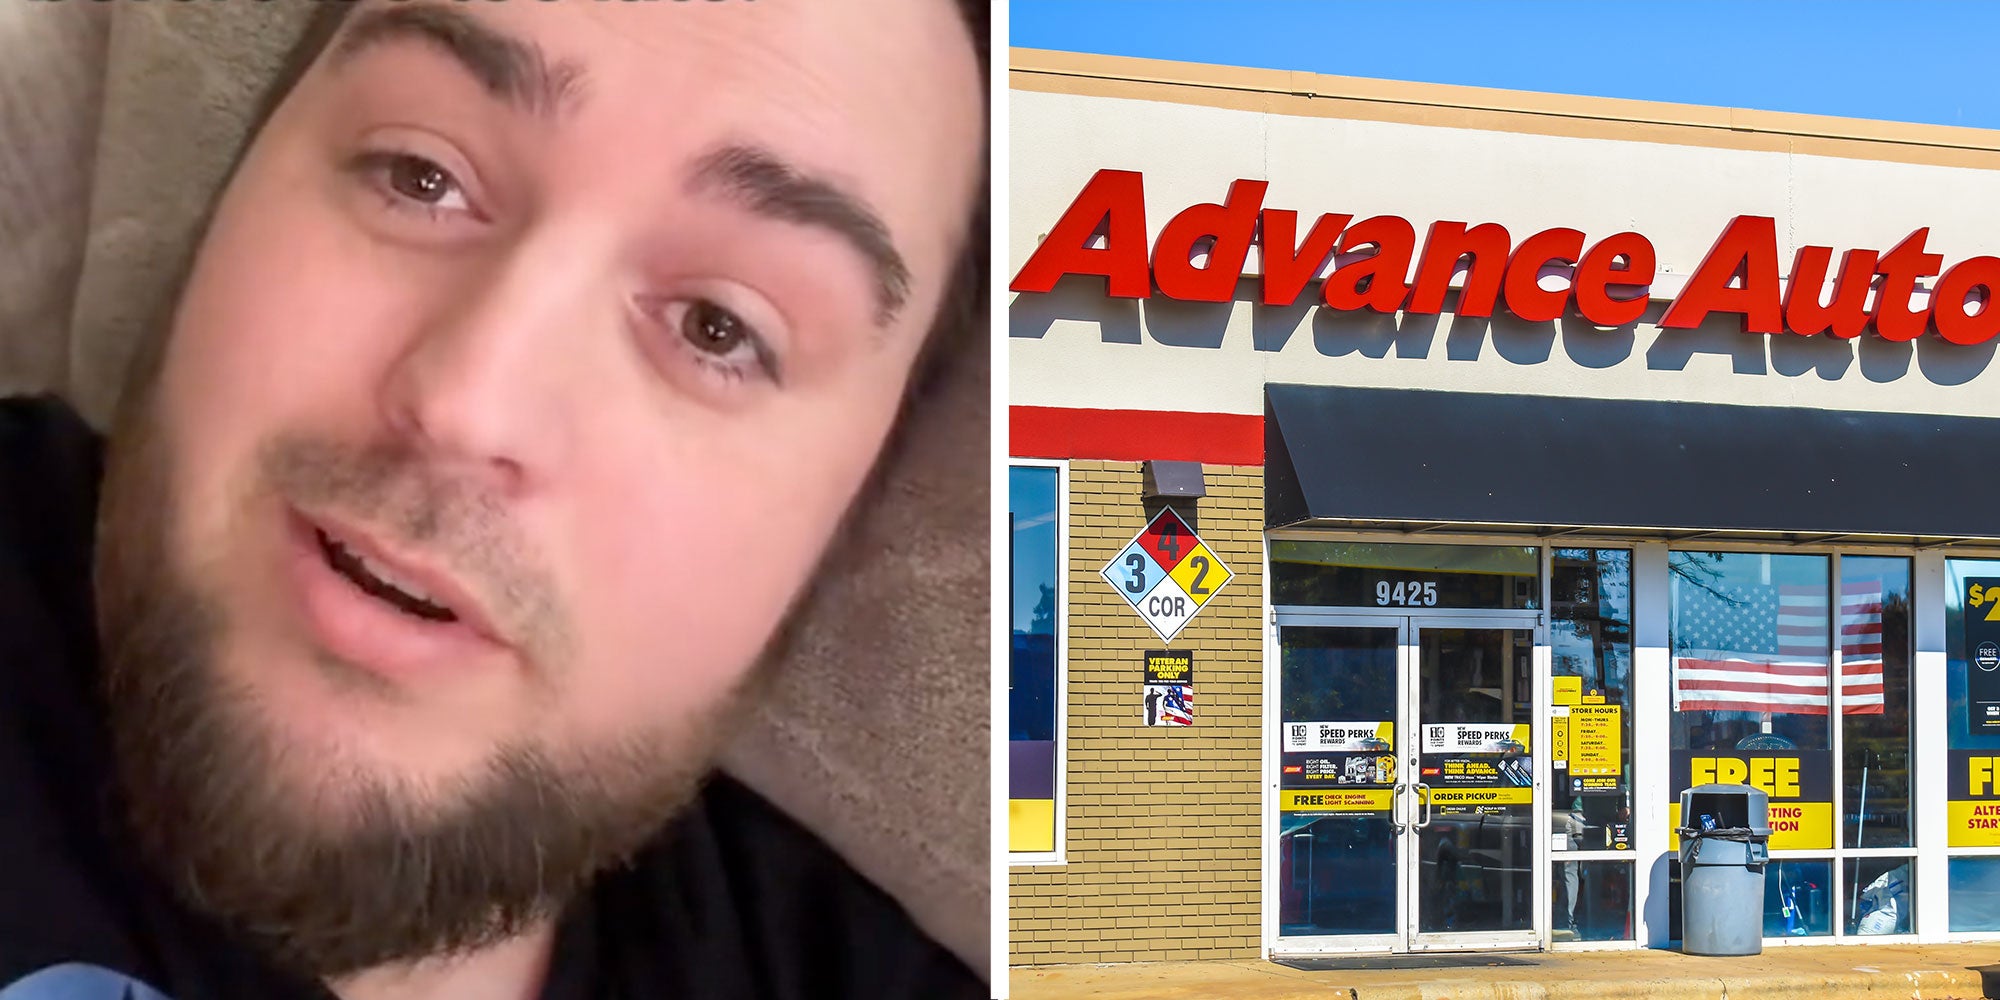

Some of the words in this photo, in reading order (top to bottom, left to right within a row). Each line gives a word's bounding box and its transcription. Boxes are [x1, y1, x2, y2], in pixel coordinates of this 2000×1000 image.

[1009, 169, 1656, 326] Advance
[1655, 215, 2000, 345] Auto
[1158, 522, 1180, 560] 4
[1125, 554, 1146, 594] 3
[1190, 556, 1210, 594] 2
[1376, 581, 1438, 606] 9425
[1149, 596, 1185, 617] COR
[1292, 726, 1306, 736] 10
[1320, 729, 1345, 738] SPEED
[1348, 729, 1374, 738] PERKS
[1430, 727, 1444, 738] 10
[1458, 731, 1482, 739] SPEED
[1484, 731, 1509, 740] PERKS
[1691, 758, 1800, 797] FREE
[1969, 757, 2000, 796] F
[1294, 795, 1323, 805] FREE
[1968, 819, 2000, 828] STAR
